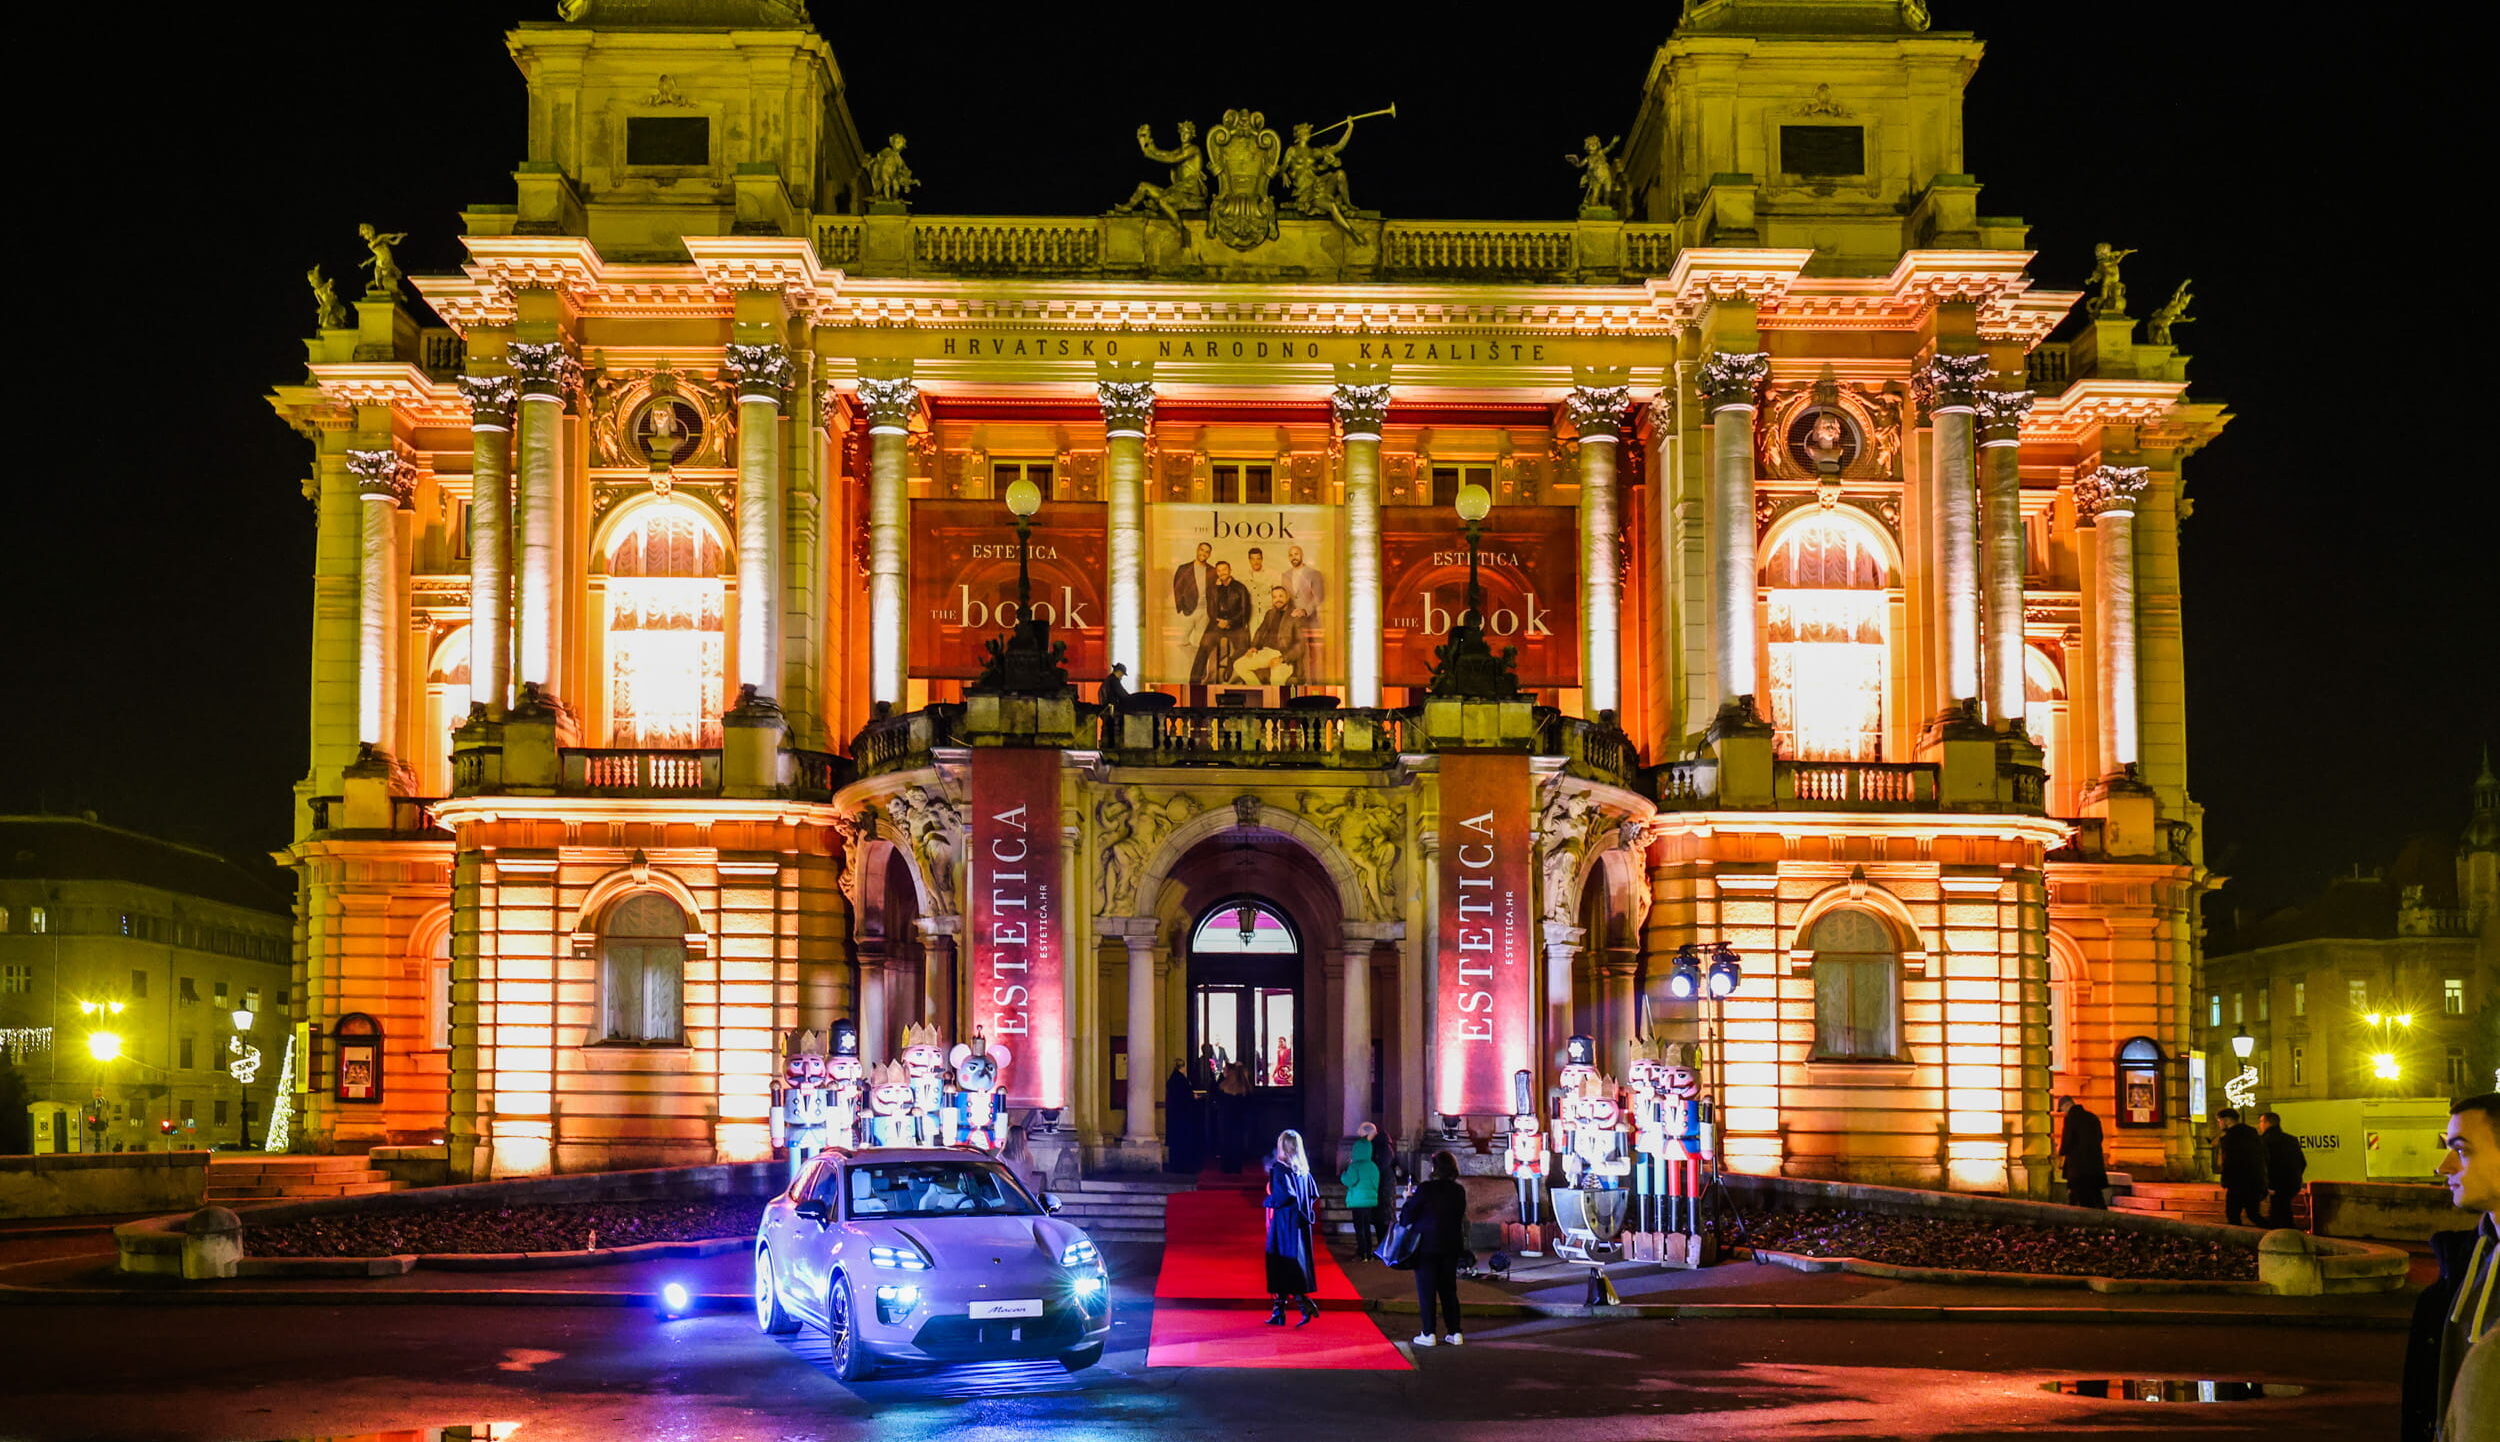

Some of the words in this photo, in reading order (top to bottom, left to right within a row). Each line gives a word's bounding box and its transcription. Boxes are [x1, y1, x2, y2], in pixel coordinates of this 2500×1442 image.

[944, 339, 1118, 356] HRVATSKO
[1159, 341, 1319, 358] NARODNO
[1360, 341, 1544, 361] KAZALIŠTE
[1211, 511, 1294, 539] book
[972, 544, 1058, 560] ESTEICA
[930, 609, 957, 620] THE
[1392, 617, 1420, 628] THE
[992, 802, 1029, 1038] ESTETICA
[1039, 884, 1048, 959] ESTETICA.HR
[1458, 809, 1494, 1044] ESTETICA
[1505, 891, 1514, 965] ESTETICA.HR
